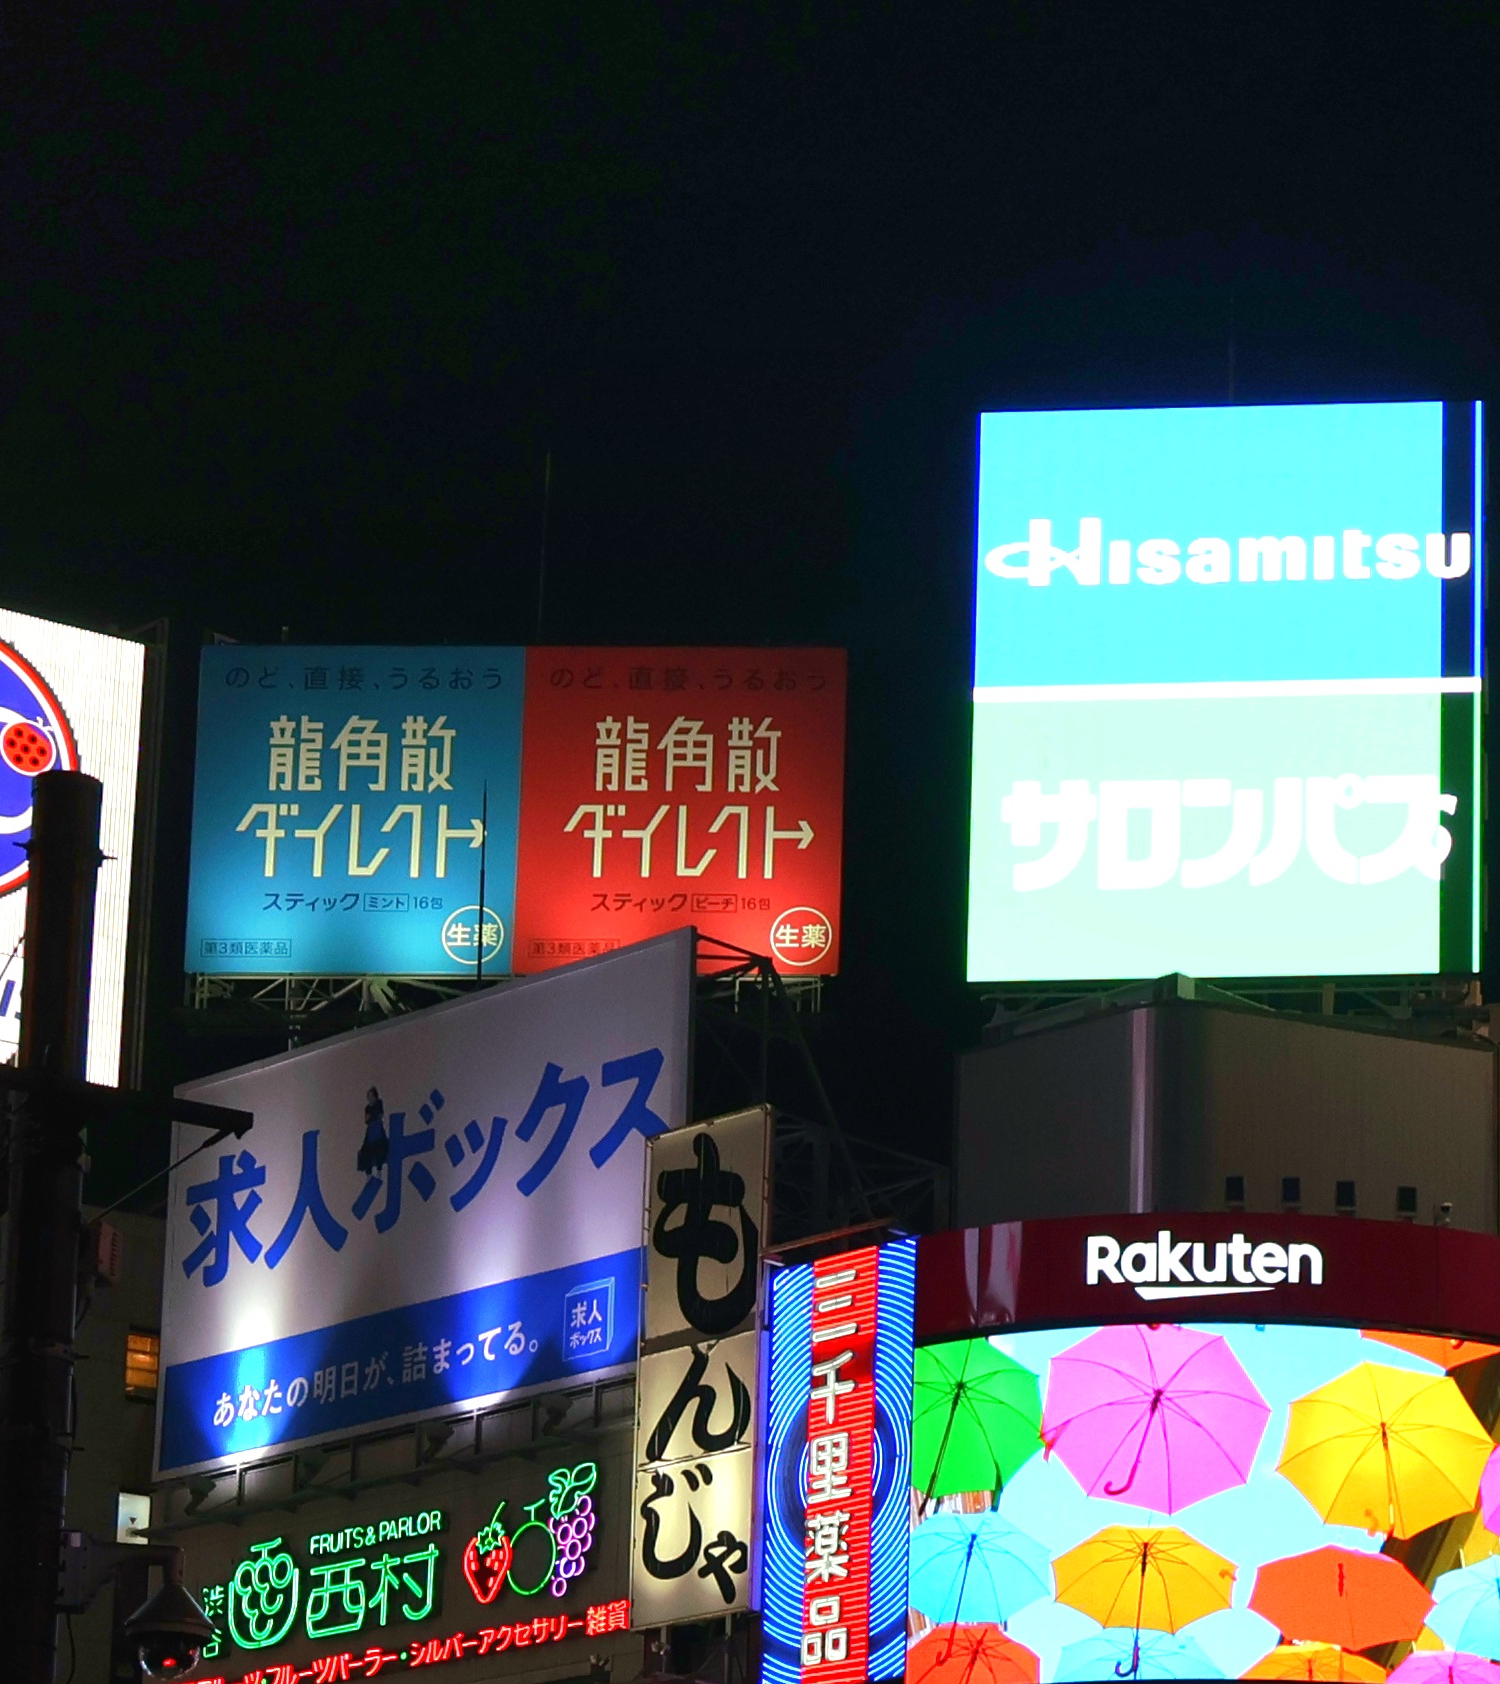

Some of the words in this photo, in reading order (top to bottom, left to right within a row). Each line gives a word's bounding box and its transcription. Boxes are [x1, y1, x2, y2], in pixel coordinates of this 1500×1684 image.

[985, 516, 1472, 588] Hisamitsu
[225, 665, 502, 693] のど、直接、うるおう
[550, 665, 828, 693] のど、直接、うるおう
[268, 713, 457, 793] 龍角散
[595, 713, 782, 794] 龍角散
[236, 803, 488, 879] ダイレクト
[563, 803, 815, 880] ダイレクト
[1001, 773, 1457, 892] サロンパス
[262, 891, 359, 912] スティック
[367, 894, 408, 911] ミント
[445, 922, 502, 950] 生薬
[590, 892, 687, 912] スティック
[773, 922, 829, 950] 生薬
[203, 939, 291, 958] 第3類医薬品
[182, 1047, 669, 1288] 求人ボックス
[1086, 1230, 1324, 1287] Rakuten
[570, 1300, 603, 1329] 求人
[212, 1319, 540, 1428] あなたの明日が、詰まってる。
[641, 1131, 759, 1604] もんじゃ
[799, 1269, 860, 1668] 三千里薬品
[307, 1543, 439, 1641] 西村
